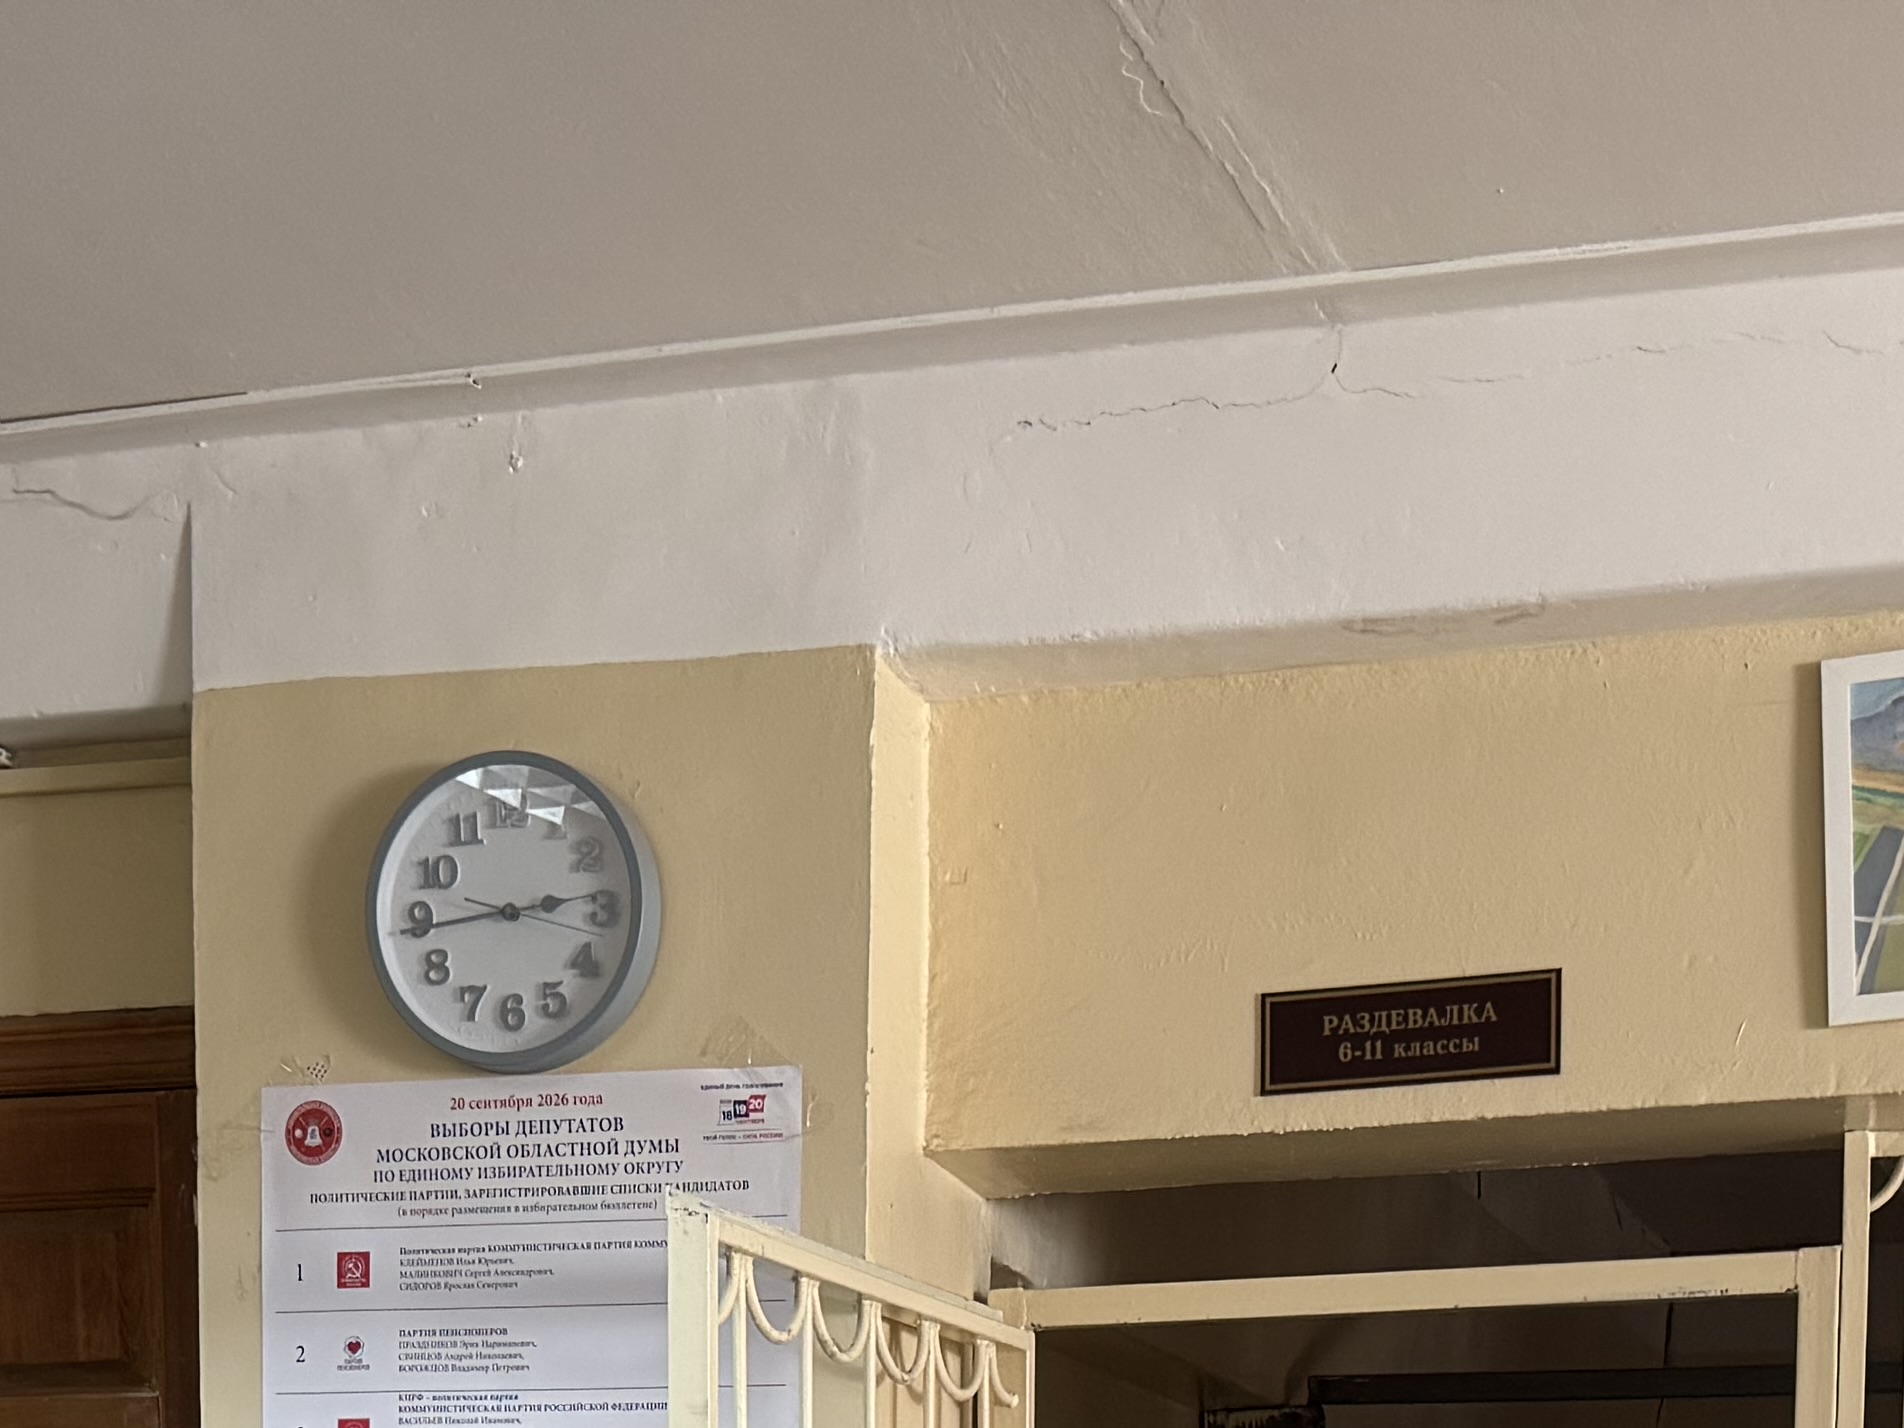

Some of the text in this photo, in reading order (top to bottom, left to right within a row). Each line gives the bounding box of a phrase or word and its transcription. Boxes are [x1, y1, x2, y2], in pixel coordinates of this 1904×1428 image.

[445, 812, 485, 847] 11
[417, 854, 459, 889] 10
[407, 901, 434, 938] 9
[424, 949, 450, 985] 8
[567, 942, 601, 977] 4
[459, 985, 488, 1021] 7
[500, 993, 526, 1032] 6
[539, 981, 567, 1019] 5
[1322, 1001, 1498, 1036] РАЗДЕВАЛКА
[1338, 1037, 1480, 1062] 6-11 классы
[449, 1094, 604, 1113] 20 сентября 2026 года
[722, 1099, 763, 1122] 18 19 20
[430, 1116, 624, 1139] ВЫБОРЫ ДЕПУТАТОВ
[376, 1138, 679, 1164] МОСКОВСКОЙ ОБЛАСТНОЙ ДУМЫ
[373, 1160, 684, 1184] ПО ЕДИНОМУ ИЗБИРАТЕЛЬНОМУ ОКРУГУ
[309, 1190, 406, 1204] ПОЛИТИЧЕСКИЕ
[463, 1184, 608, 1200] ЗАРЕГИСТРИРОВАВШИЕ
[610, 1182, 663, 1195] СПИСКИ
[297, 1264, 303, 1281] 1
[296, 1345, 305, 1363] 2
